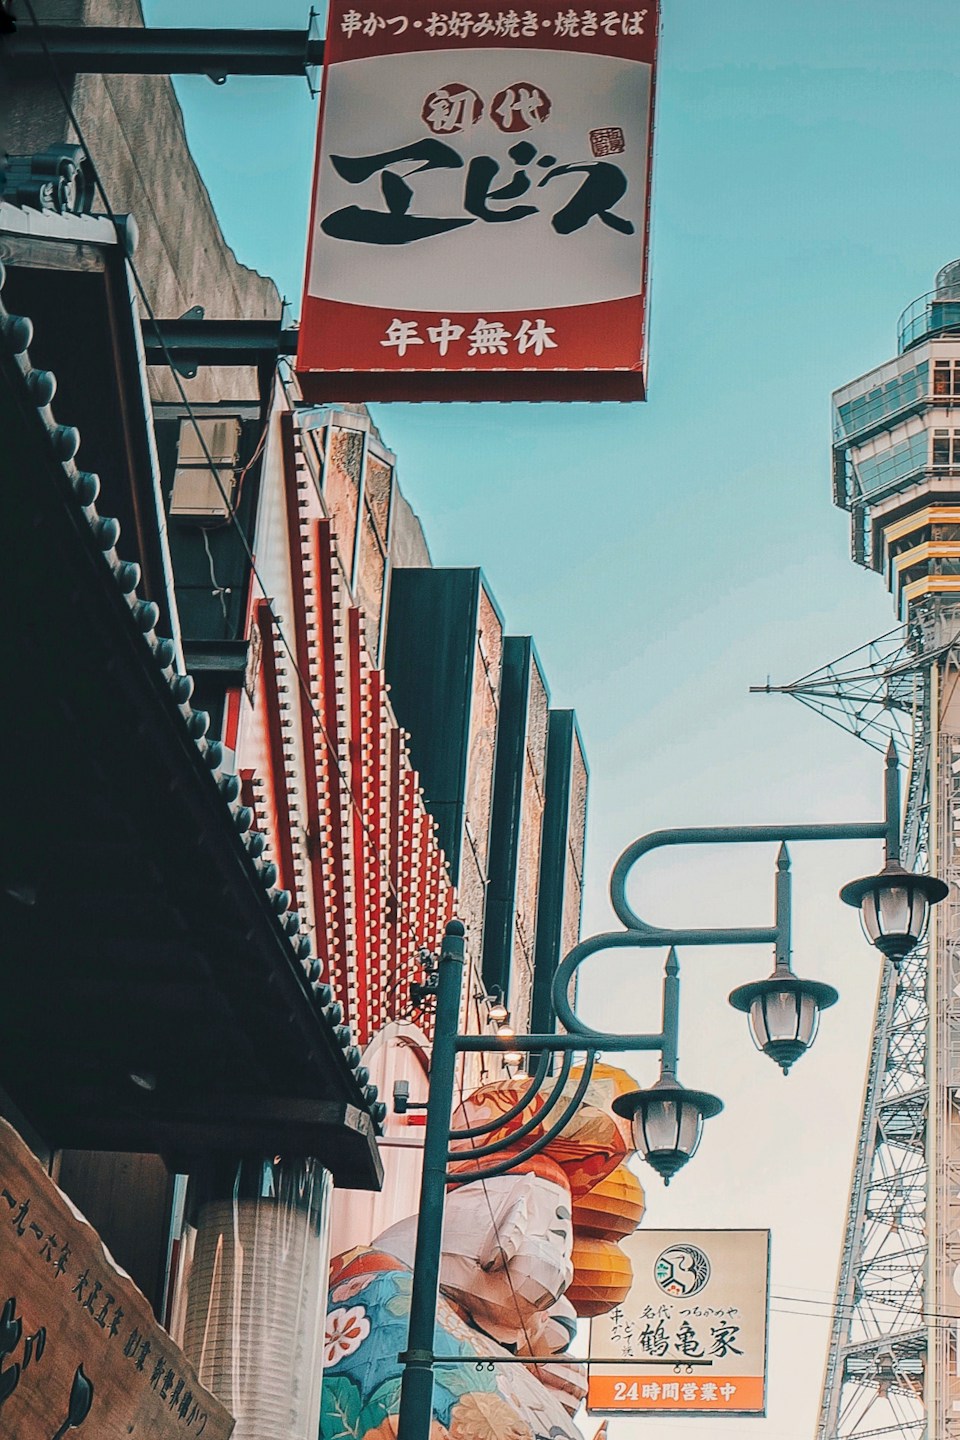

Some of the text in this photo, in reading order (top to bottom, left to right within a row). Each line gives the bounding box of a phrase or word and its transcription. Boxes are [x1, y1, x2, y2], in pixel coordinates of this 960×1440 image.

[340, 9, 647, 39] 串かつ・お好み焼き・焼きそば
[422, 83, 552, 134] 初代
[379, 318, 558, 357] 年中無休
[639, 1304, 674, 1320] 名代
[638, 1318, 744, 1358] 鶴亀家
[613, 1382, 737, 1402] 24時間営業中
